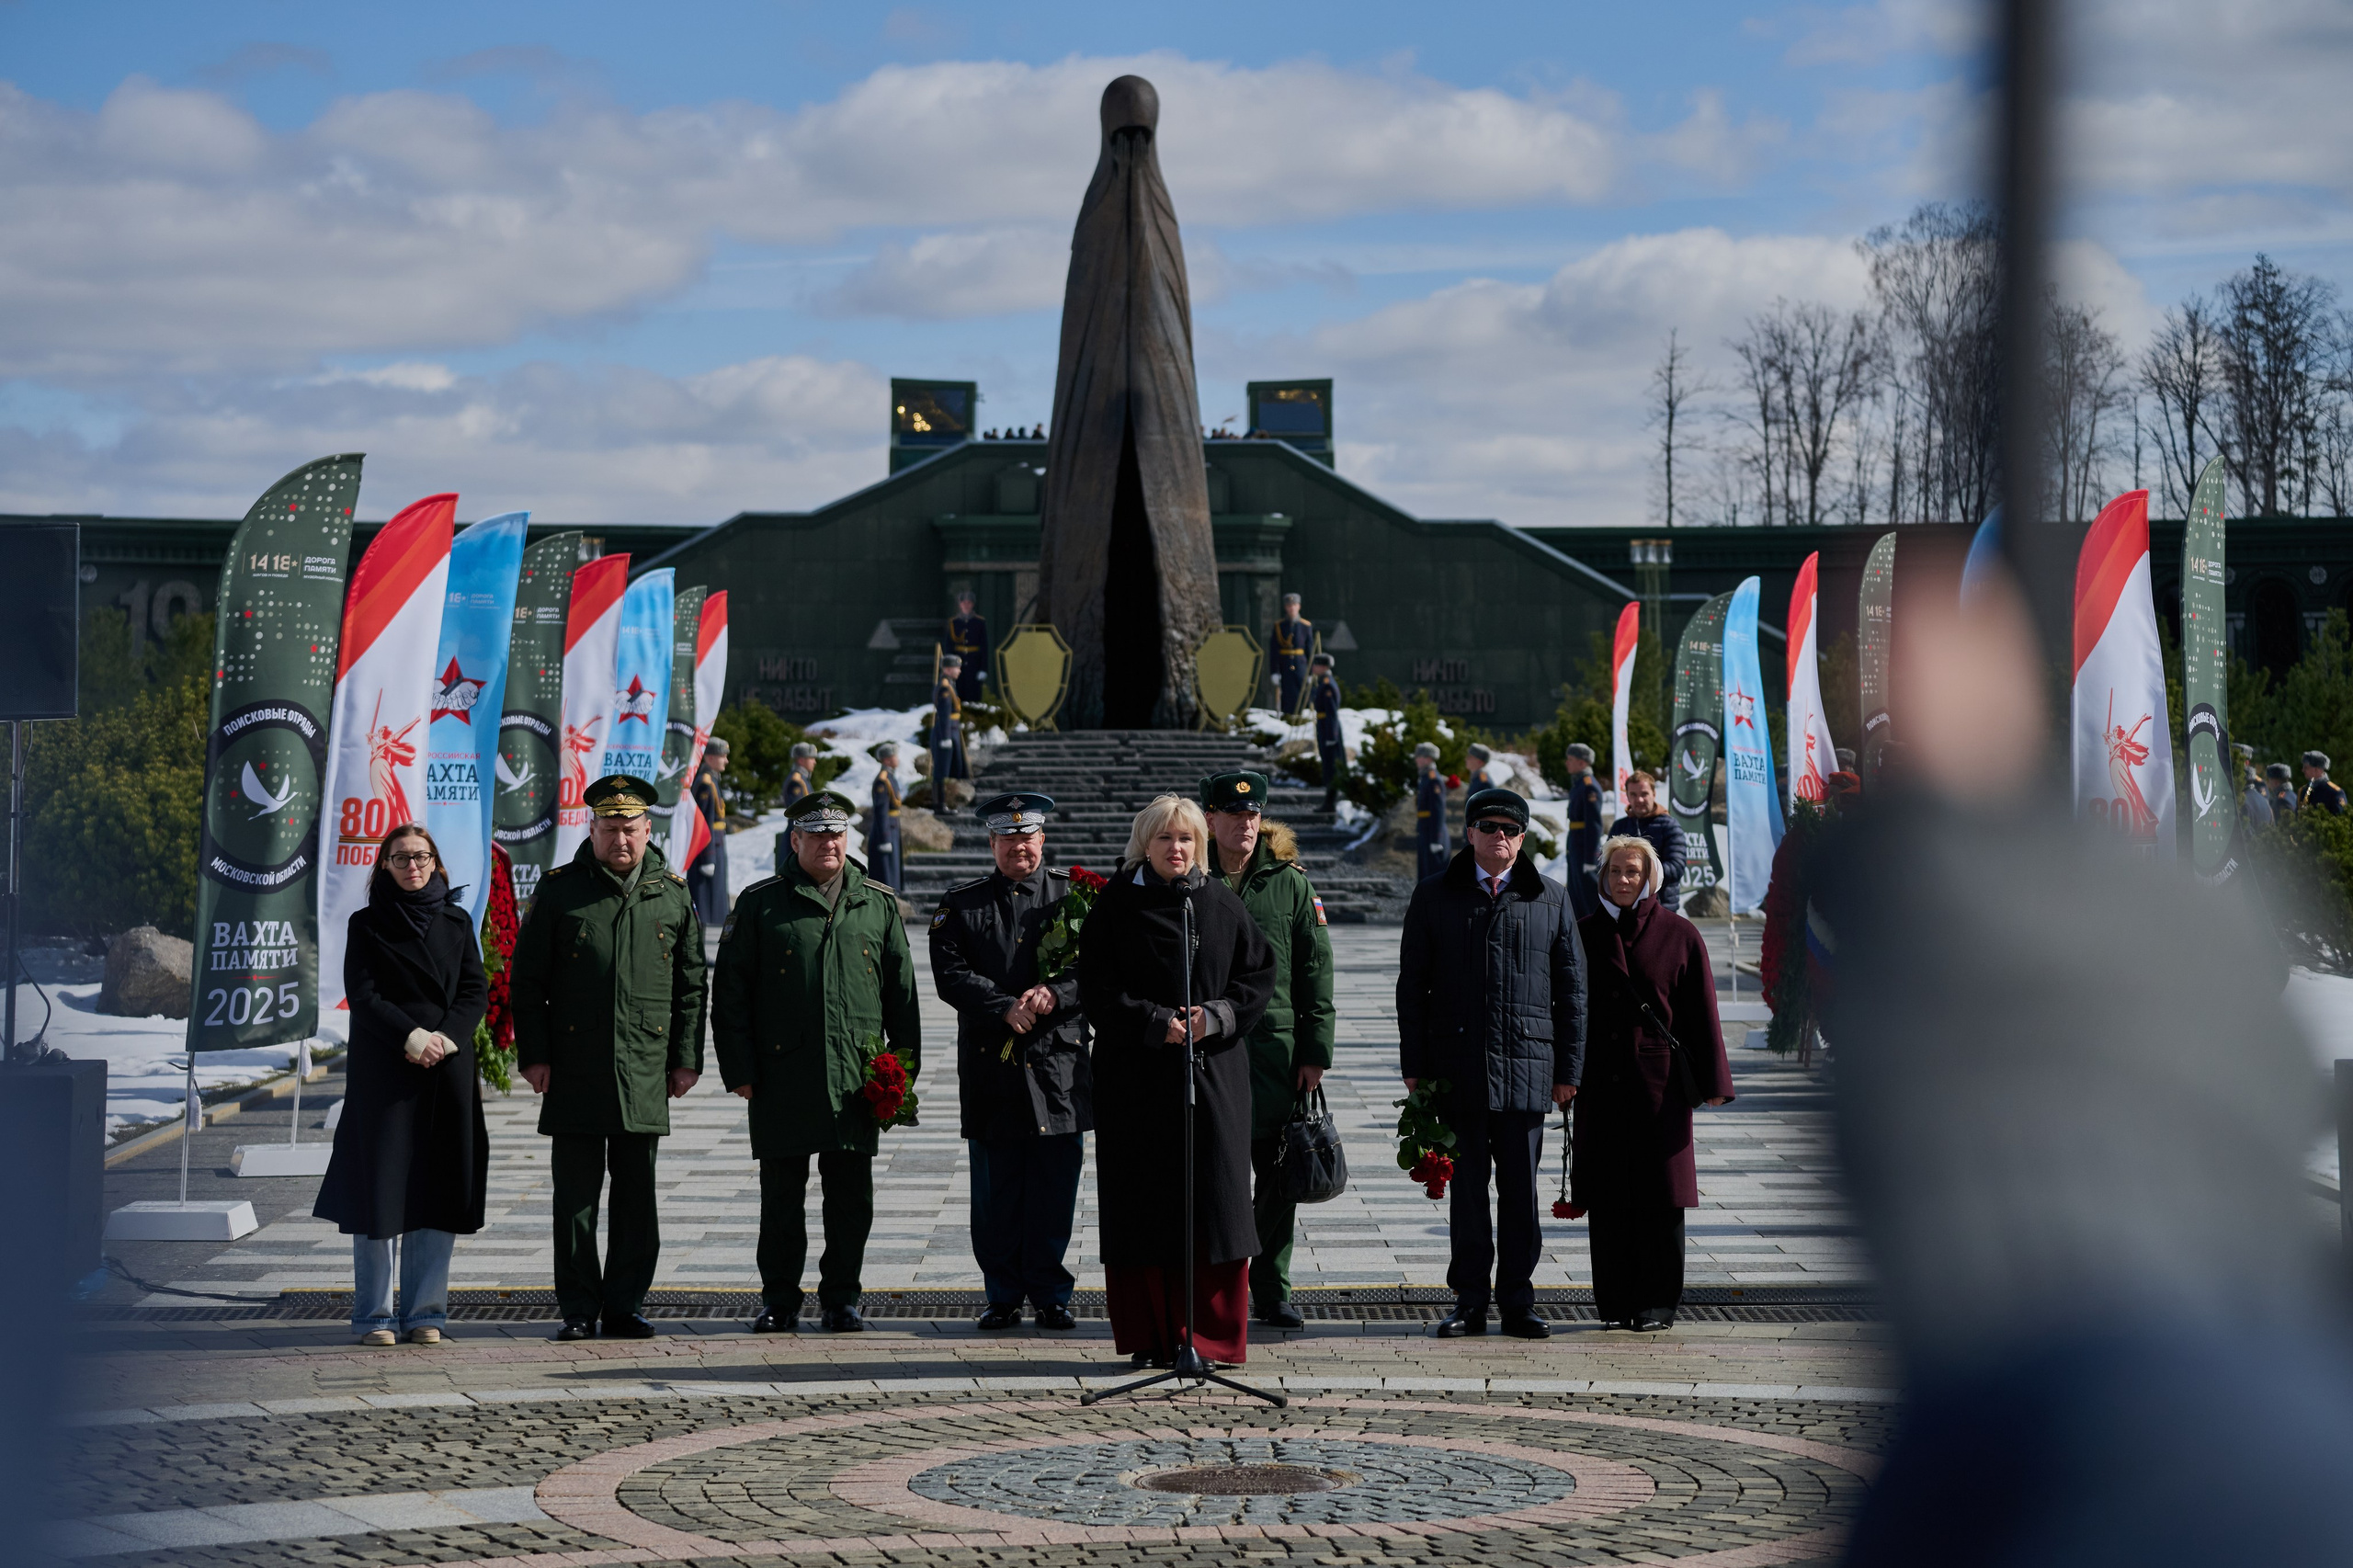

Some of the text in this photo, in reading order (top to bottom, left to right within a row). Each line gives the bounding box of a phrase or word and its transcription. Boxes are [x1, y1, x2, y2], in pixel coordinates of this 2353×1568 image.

[303, 565, 336, 574] ПАМЯТИ
[759, 657, 818, 681] НИКТО
[1413, 658, 1469, 681] НИЧТО
[772, 686, 833, 711] ЗАБЫТ
[222, 708, 317, 739] ПОИСКОВЫЕ ОТРЯДЫ
[523, 717, 552, 735] ОТРЯДЫ
[604, 752, 653, 768] ВАХТА
[1733, 753, 1766, 771] ВАХТА
[339, 797, 386, 837] 80
[522, 817, 553, 838] ОБЛАСТИ
[210, 855, 307, 886] МОСКОВСКОЙ ОБЛАСТИ
[211, 921, 299, 948] ВАХТА
[210, 948, 299, 971] ПАМЯТИ
[204, 981, 300, 1027] 2025
